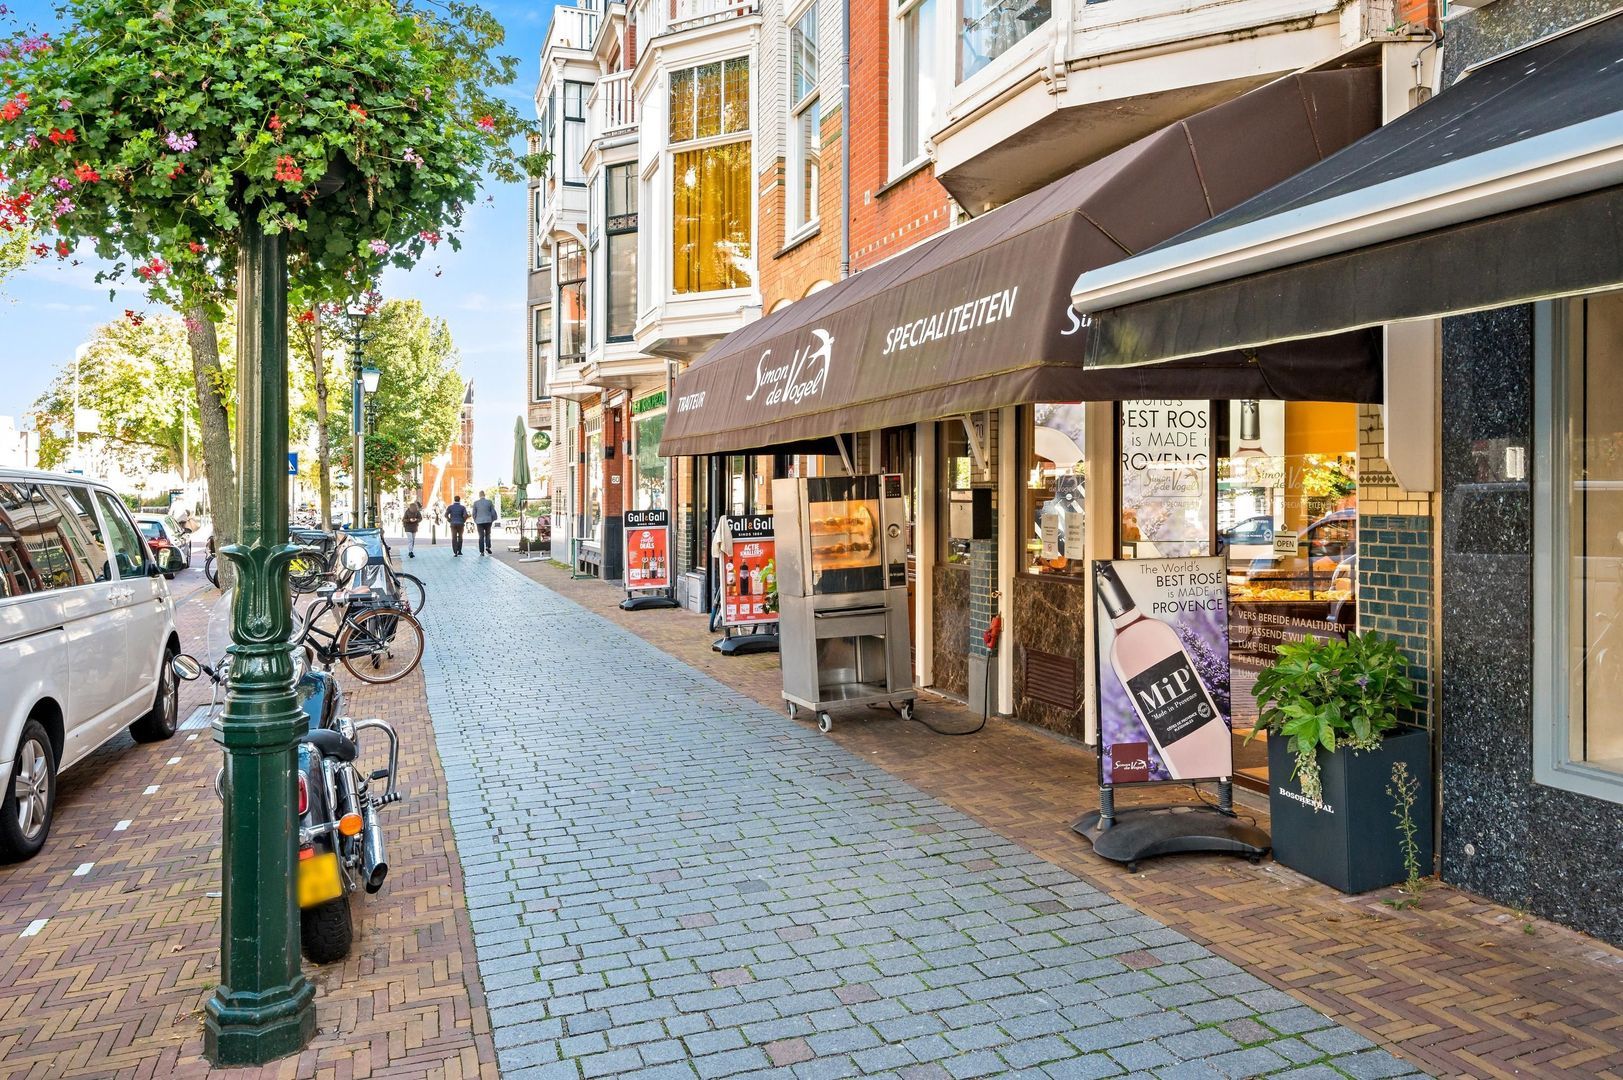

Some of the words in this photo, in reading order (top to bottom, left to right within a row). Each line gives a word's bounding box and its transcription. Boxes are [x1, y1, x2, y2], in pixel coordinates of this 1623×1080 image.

[883, 286, 1018, 355] SPECIALITEITEN
[745, 349, 790, 401] Simon
[765, 382, 782, 406] de
[781, 344, 825, 404] Vogel
[677, 391, 706, 413] TRAITEUR
[1131, 432, 1142, 447] is
[1147, 432, 1198, 447] MADE
[1276, 540, 1295, 548] OPEN
[1140, 564, 1158, 574] The
[1161, 561, 1200, 573] World's
[1156, 574, 1185, 588] BEST
[1189, 569, 1222, 585] ROSÉ
[1167, 589, 1175, 598] is
[1178, 586, 1210, 598] MADE
[1213, 587, 1223, 596] in
[1152, 598, 1224, 614] PROVENCE
[1238, 610, 1257, 620] VERS
[1258, 613, 1290, 626] BEREIDE
[1291, 617, 1346, 633] MAALTIJDEN
[1238, 625, 1287, 641] BIJPASSENDE
[1238, 640, 1257, 650] LUXE
[1238, 654, 1276, 669] PLATEAUS
[1137, 667, 1191, 714] MiP
